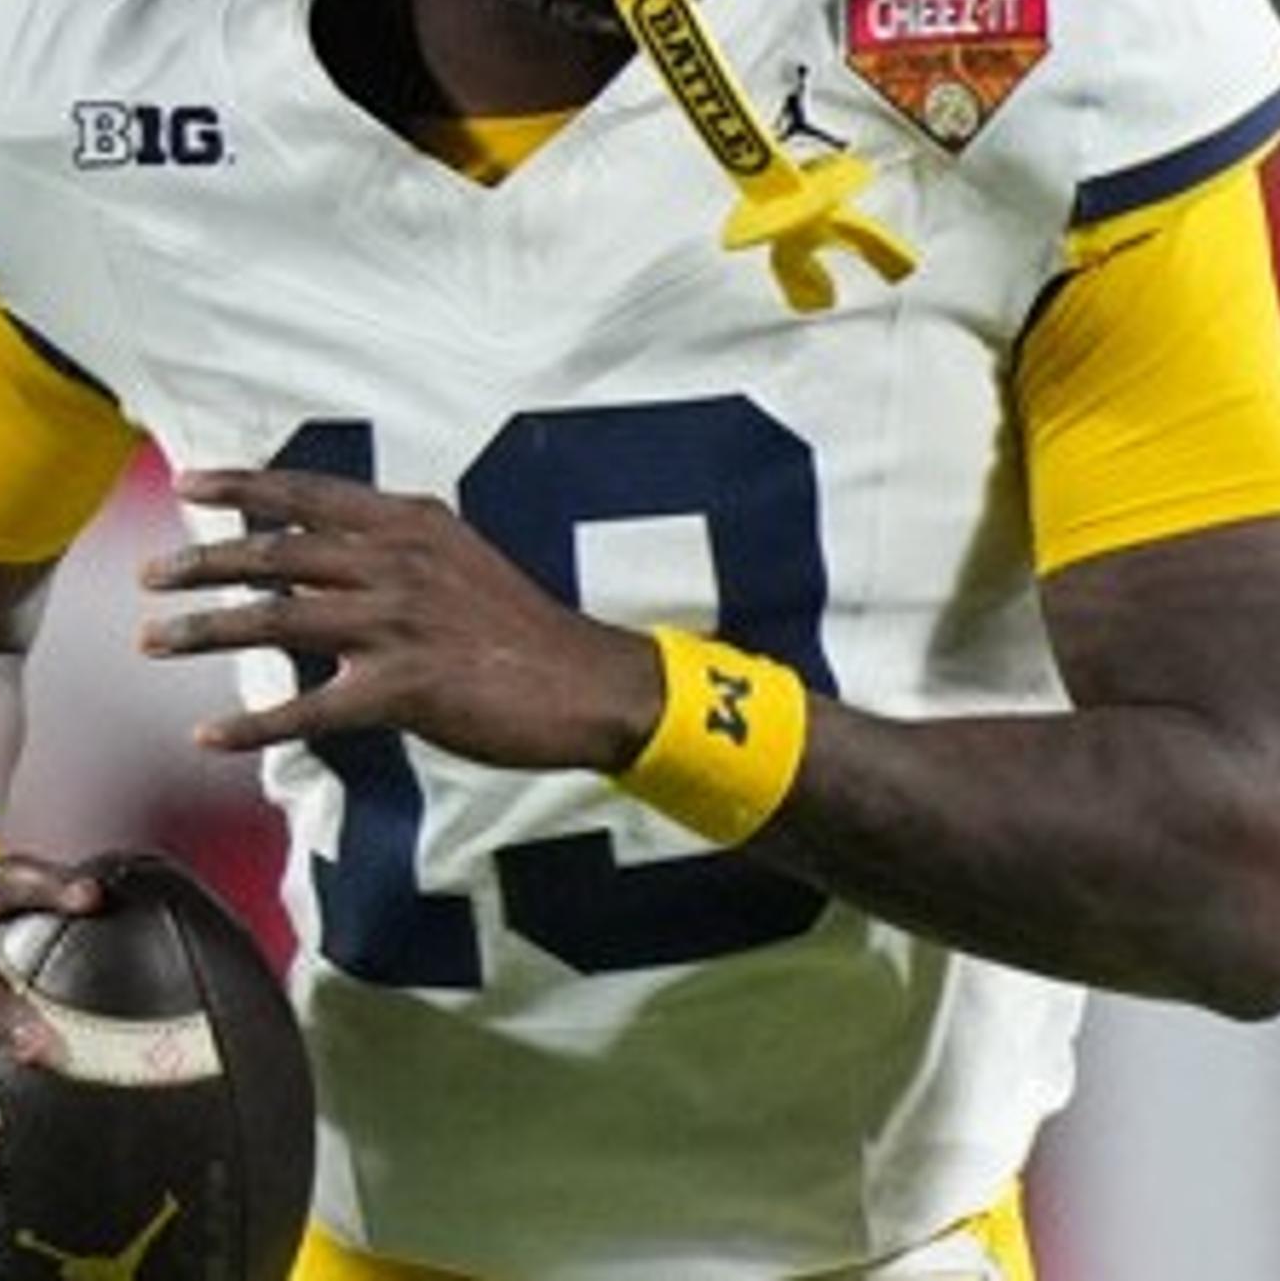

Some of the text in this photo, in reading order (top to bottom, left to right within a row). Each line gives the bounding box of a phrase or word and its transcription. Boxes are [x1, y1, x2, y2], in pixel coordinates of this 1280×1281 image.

[648, 3, 757, 161] BATTLE
[240, 393, 841, 991] 19
[705, 665, 752, 747] M
